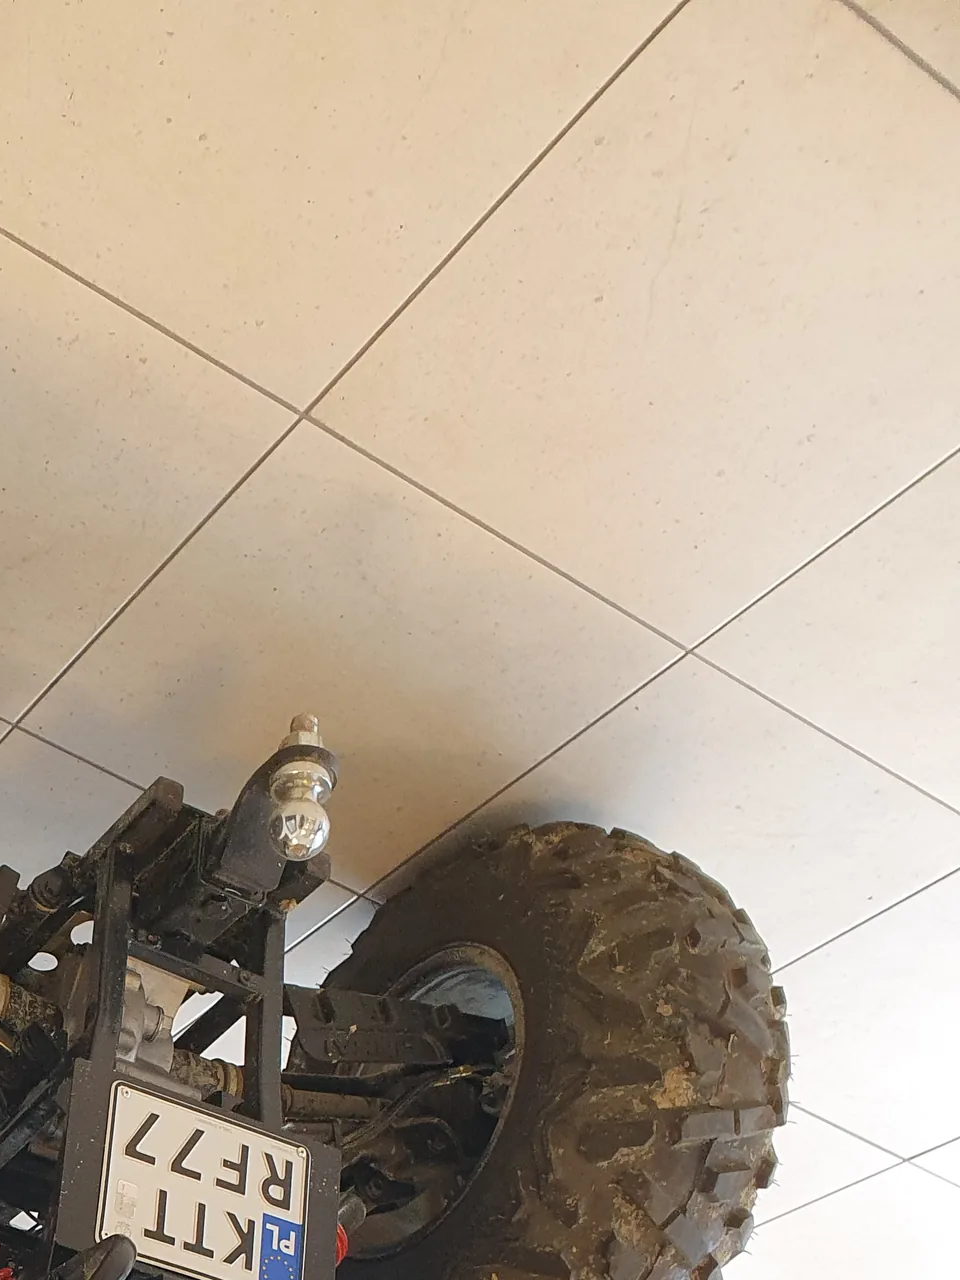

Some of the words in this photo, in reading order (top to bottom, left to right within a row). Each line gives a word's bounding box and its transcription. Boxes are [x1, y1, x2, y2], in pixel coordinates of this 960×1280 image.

[124, 1112, 293, 1211] RF77
[143, 1188, 255, 1271] KTT
[266, 1222, 296, 1256] PL
